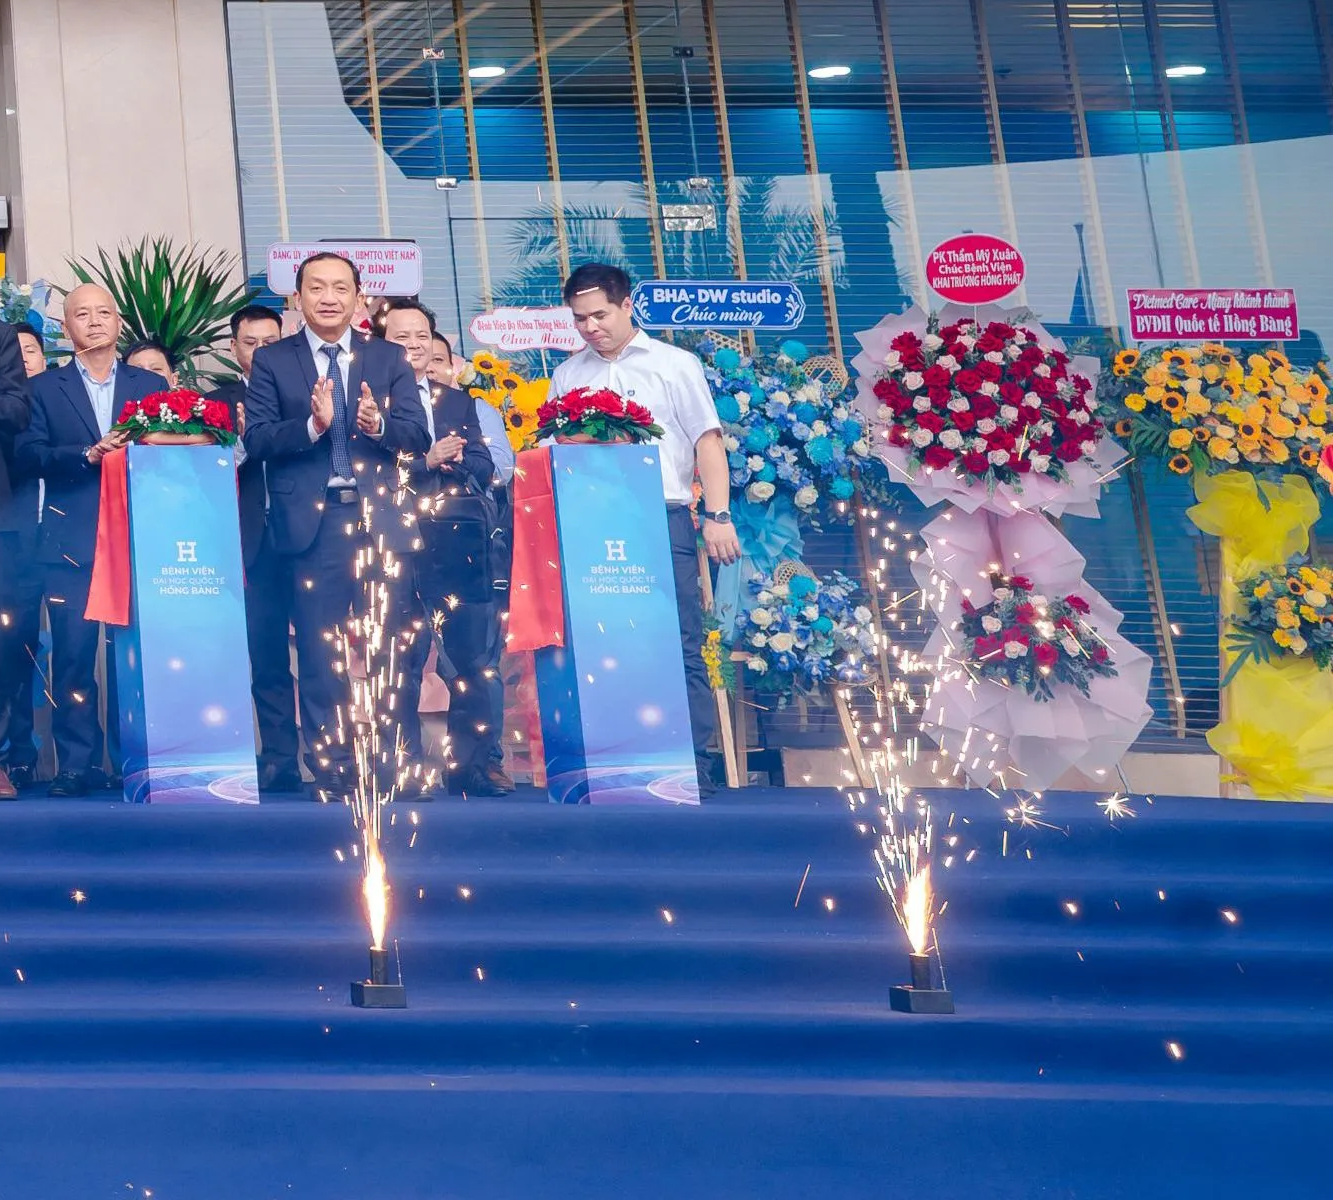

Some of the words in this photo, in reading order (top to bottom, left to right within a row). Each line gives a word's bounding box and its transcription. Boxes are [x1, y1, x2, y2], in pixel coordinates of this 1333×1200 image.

[400, 250, 417, 260] NAM
[933, 251, 946, 263] PK
[975, 249, 990, 263] Mỹ
[992, 248, 1018, 261] Xuân
[938, 264, 964, 274] Chúc
[964, 263, 989, 275] Bệnh
[990, 261, 1012, 273] Viện
[933, 277, 950, 288] KHAI
[653, 288, 695, 304] BHA-
[697, 288, 728, 304] DW
[731, 288, 782, 305] studio
[1233, 292, 1261, 309] khánh
[1263, 292, 1290, 309] thành
[671, 304, 718, 323] Chúc
[719, 306, 765, 327] mừng
[1136, 314, 1172, 333] BVĐH
[1174, 313, 1205, 335] Quốc
[1208, 313, 1221, 333] tế
[1223, 314, 1257, 336] Hồng
[1259, 314, 1293, 337] Bàng
[176, 541, 198, 562] H
[604, 540, 627, 561] H
